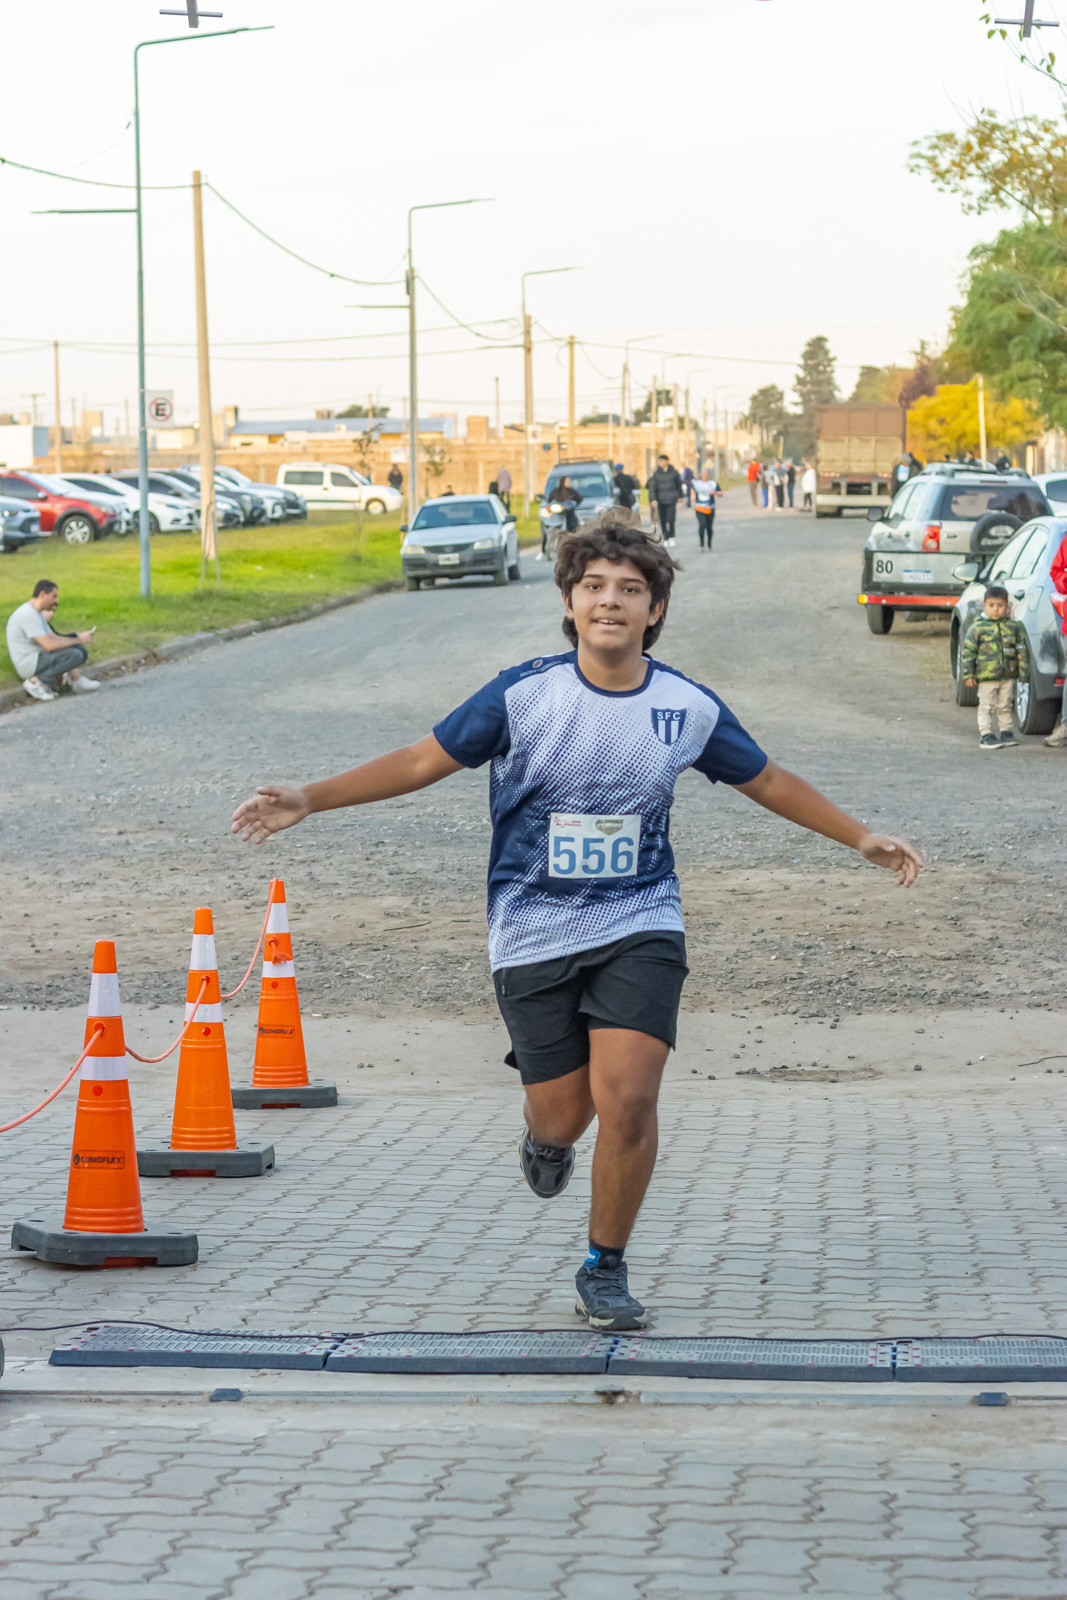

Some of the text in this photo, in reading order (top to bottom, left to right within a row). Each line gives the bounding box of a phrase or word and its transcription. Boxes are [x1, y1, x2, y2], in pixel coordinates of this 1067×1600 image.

[155, 402, 167, 416] E
[876, 559, 893, 574] 80
[657, 711, 681, 721] SFC
[553, 836, 634, 875] 556
[80, 1156, 123, 1164] CONOFLEX
